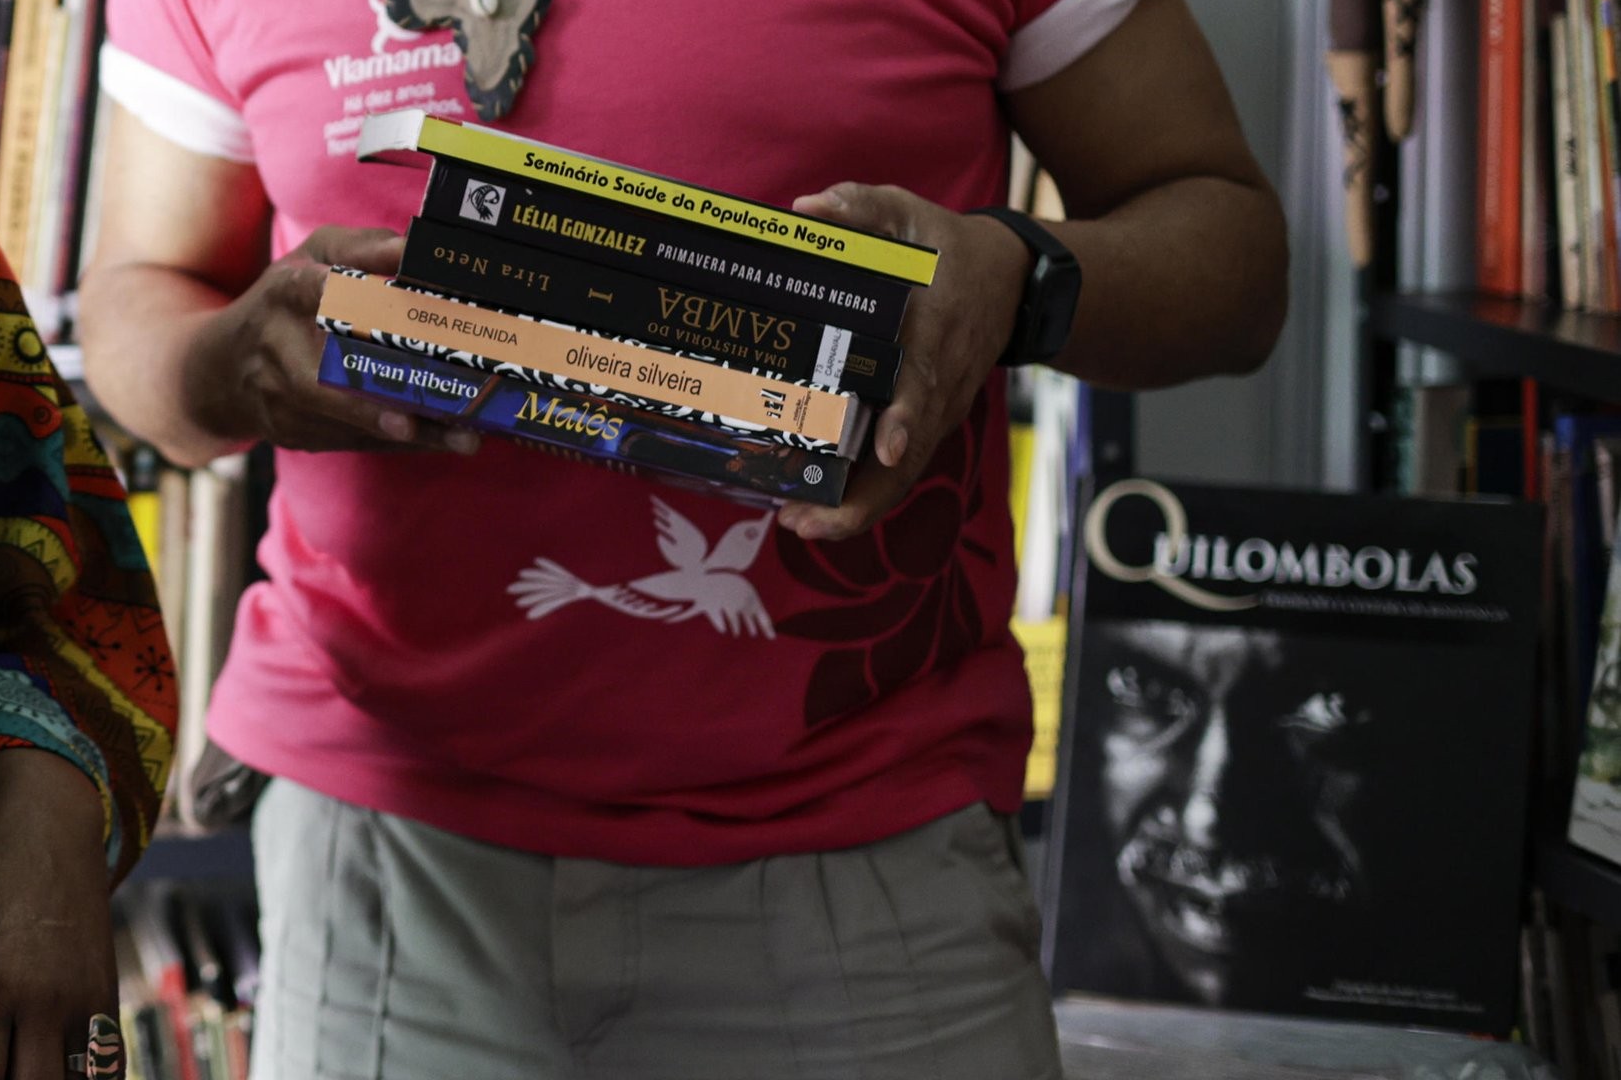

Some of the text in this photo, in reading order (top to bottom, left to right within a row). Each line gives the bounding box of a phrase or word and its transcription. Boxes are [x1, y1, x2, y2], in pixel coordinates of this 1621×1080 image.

[395, 82, 436, 102] anos
[523, 152, 846, 252] Seminário Saúde da População Negra
[433, 247, 551, 292] Lira Neto
[512, 203, 878, 315] LÉLIA GONZALEZ PRIMAVERA PARA AS ROSAS NEGRAS
[406, 307, 519, 346] OBRA REUNIDA
[657, 286, 797, 351] SAMBA
[647, 321, 789, 369] UMA HISTÓRIA DO
[342, 353, 479, 399] Gilvan Ribeiro
[565, 345, 703, 396] oliveira silveira
[514, 391, 625, 441] Malês
[1083, 478, 1479, 612] QUILOMBOLAS
